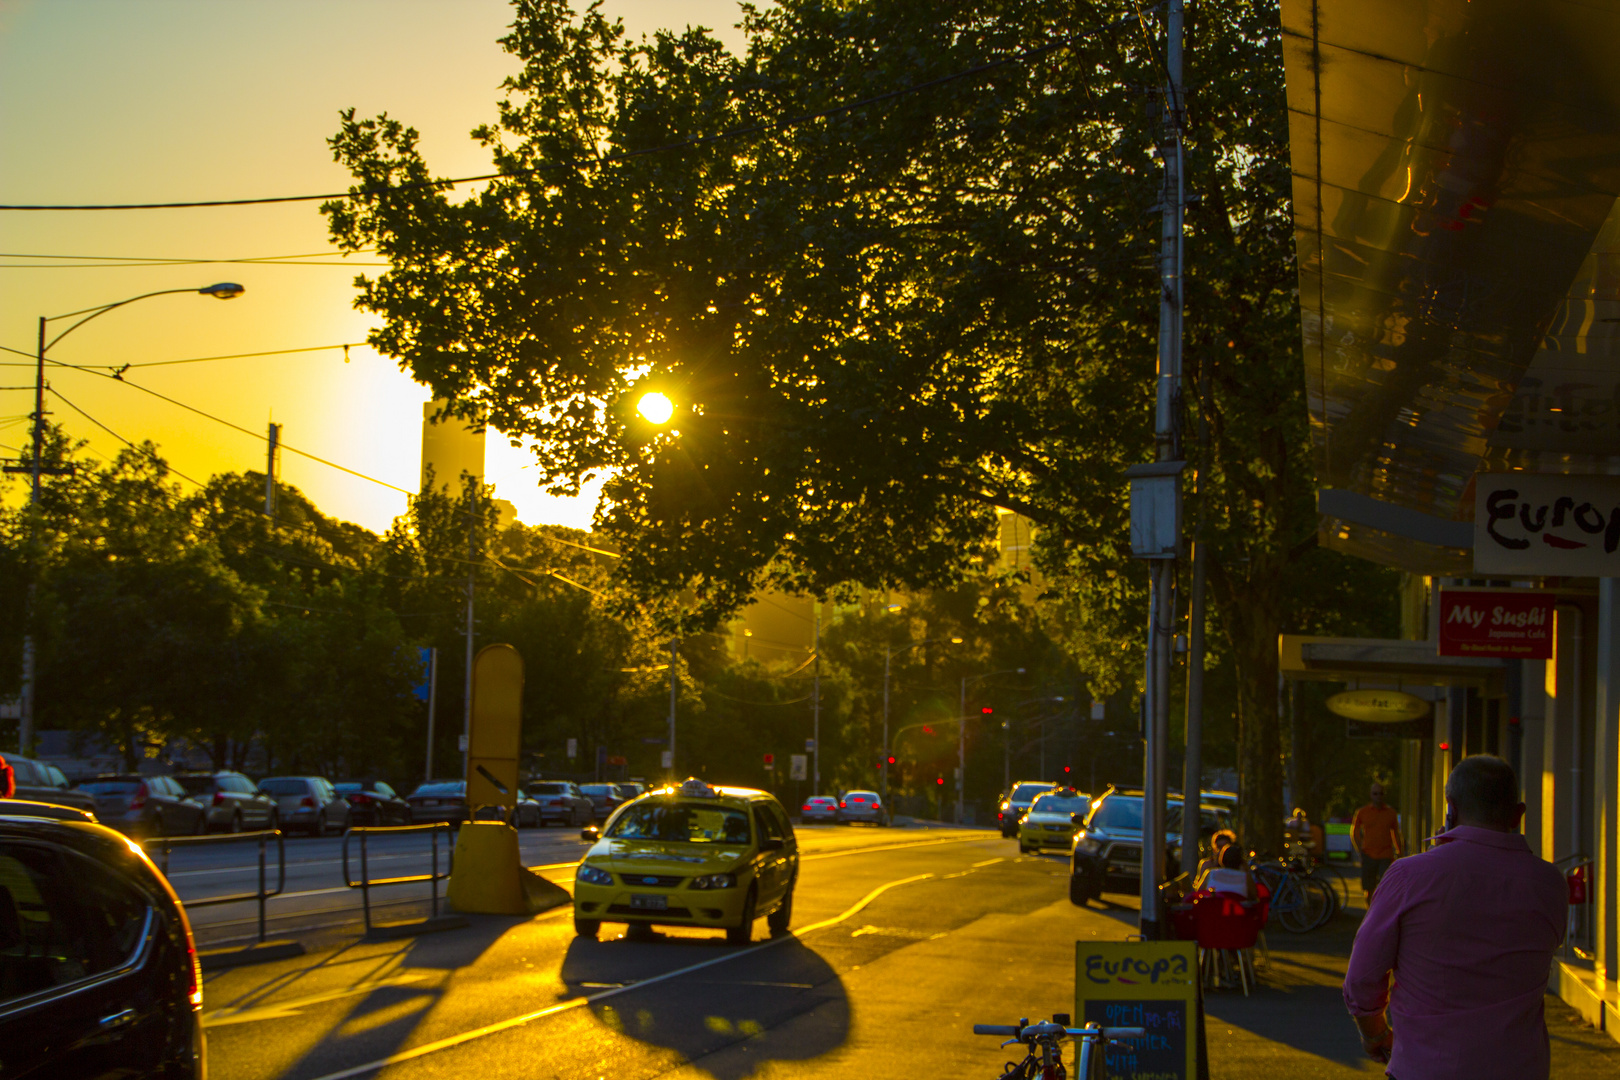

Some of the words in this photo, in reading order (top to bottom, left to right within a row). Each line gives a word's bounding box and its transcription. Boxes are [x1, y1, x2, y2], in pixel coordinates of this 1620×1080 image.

[1446, 604, 1486, 629] My
[1490, 605, 1547, 628] Sushi
[1085, 954, 1188, 984] Europa
[1106, 1003, 1143, 1028] OPEN
[1105, 1054, 1138, 1072] WITH
